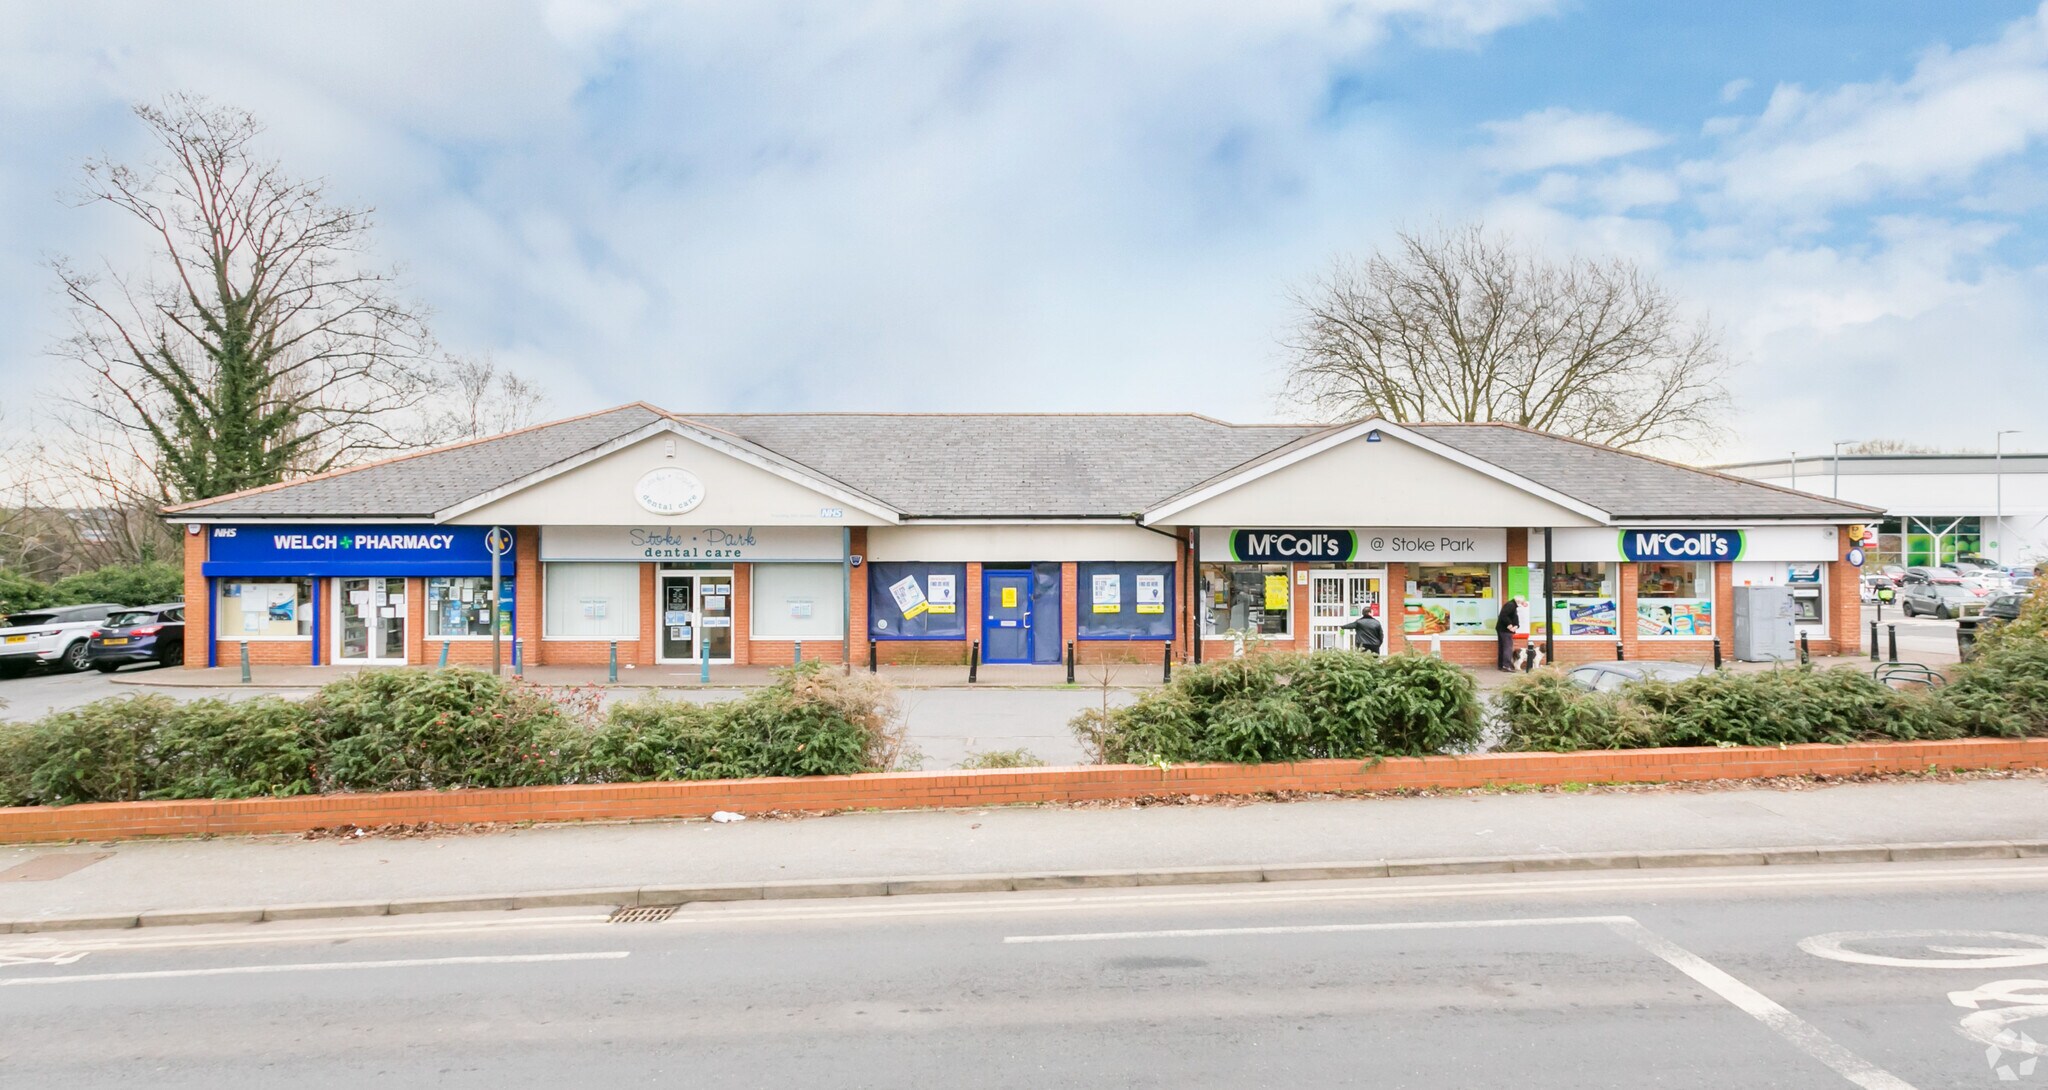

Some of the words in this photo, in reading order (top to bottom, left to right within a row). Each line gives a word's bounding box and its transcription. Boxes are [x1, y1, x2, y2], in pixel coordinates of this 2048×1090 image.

[643, 494, 673, 511] dental
[678, 494, 697, 509] care
[821, 508, 843, 518] NHS
[214, 528, 237, 538] NHS
[629, 526, 682, 547] Stoke
[702, 527, 757, 547] Park
[273, 535, 338, 550] WELCH
[354, 535, 454, 550] PHARMACY
[1248, 533, 1339, 556] McColl's
[1370, 536, 1385, 552] @
[1391, 536, 1436, 552] Stoke
[1440, 537, 1475, 552] Park
[1636, 532, 1729, 556] McColl's
[644, 548, 698, 558] dental
[705, 549, 742, 558] care
